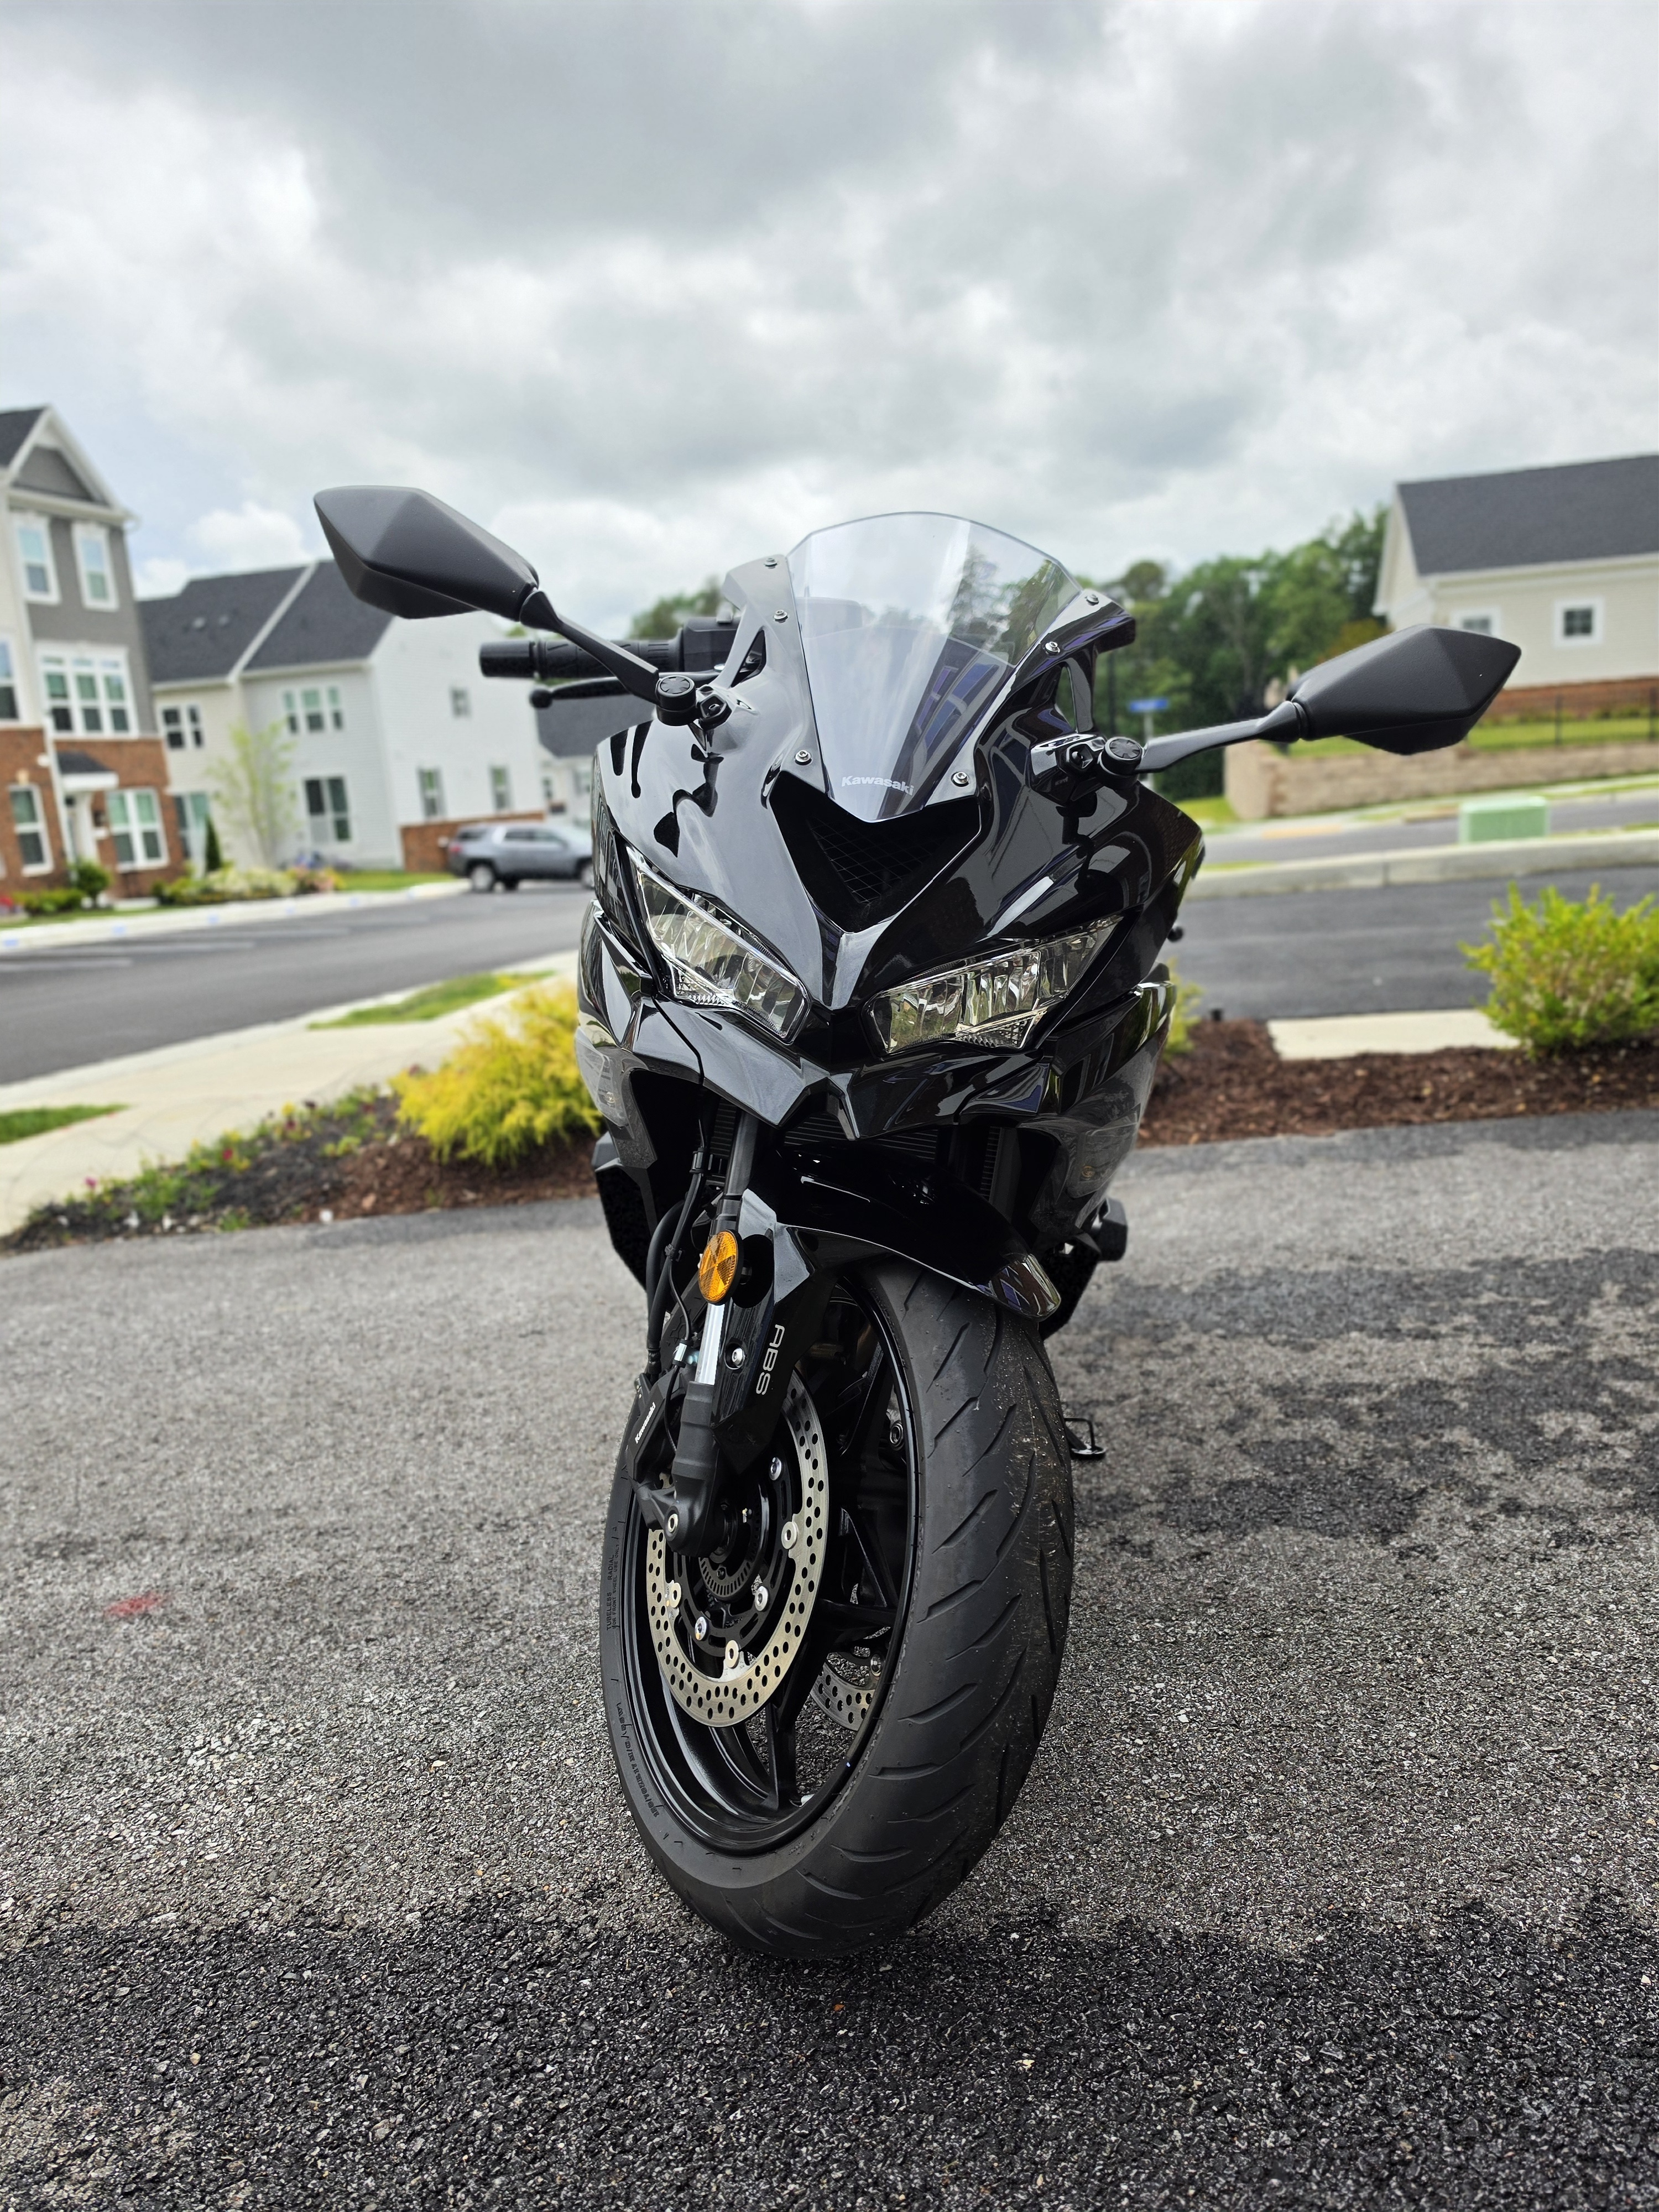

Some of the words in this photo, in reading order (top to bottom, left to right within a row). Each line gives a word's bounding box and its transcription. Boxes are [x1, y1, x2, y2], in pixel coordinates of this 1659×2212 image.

[842, 775, 914, 796] Kawasaki
[755, 1324, 785, 1395] ABS
[634, 1402, 656, 1444] Kawasaki
